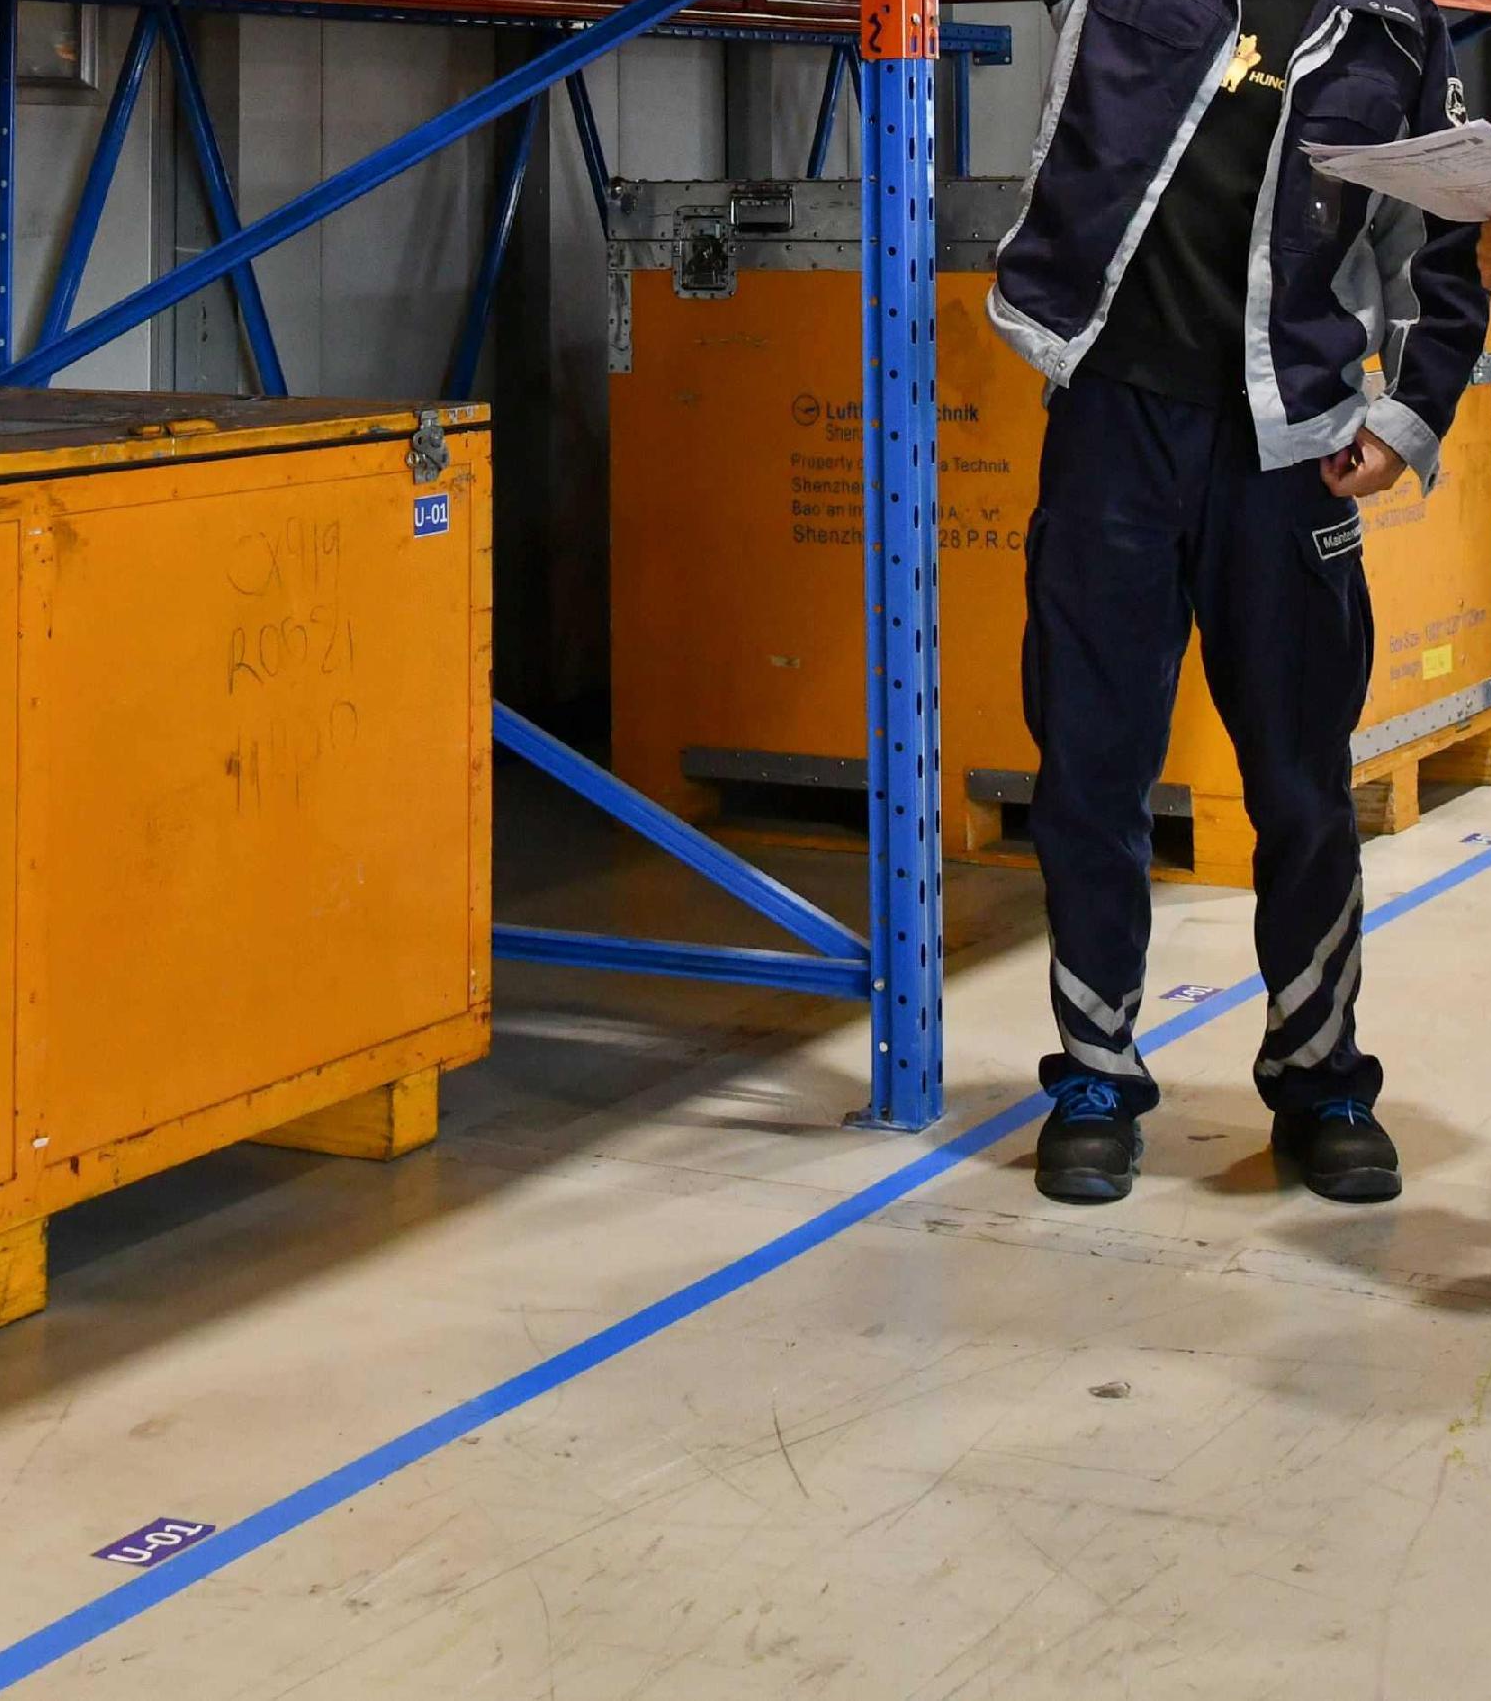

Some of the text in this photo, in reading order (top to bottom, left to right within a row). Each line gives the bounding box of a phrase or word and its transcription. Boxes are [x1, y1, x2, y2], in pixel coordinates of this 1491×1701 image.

[789, 452, 1011, 475] Property Technik
[790, 476, 864, 494] Shenzhe
[414, 503, 448, 528] U-01
[792, 524, 864, 546] Shenzh
[107, 1524, 203, 1564] U-01
